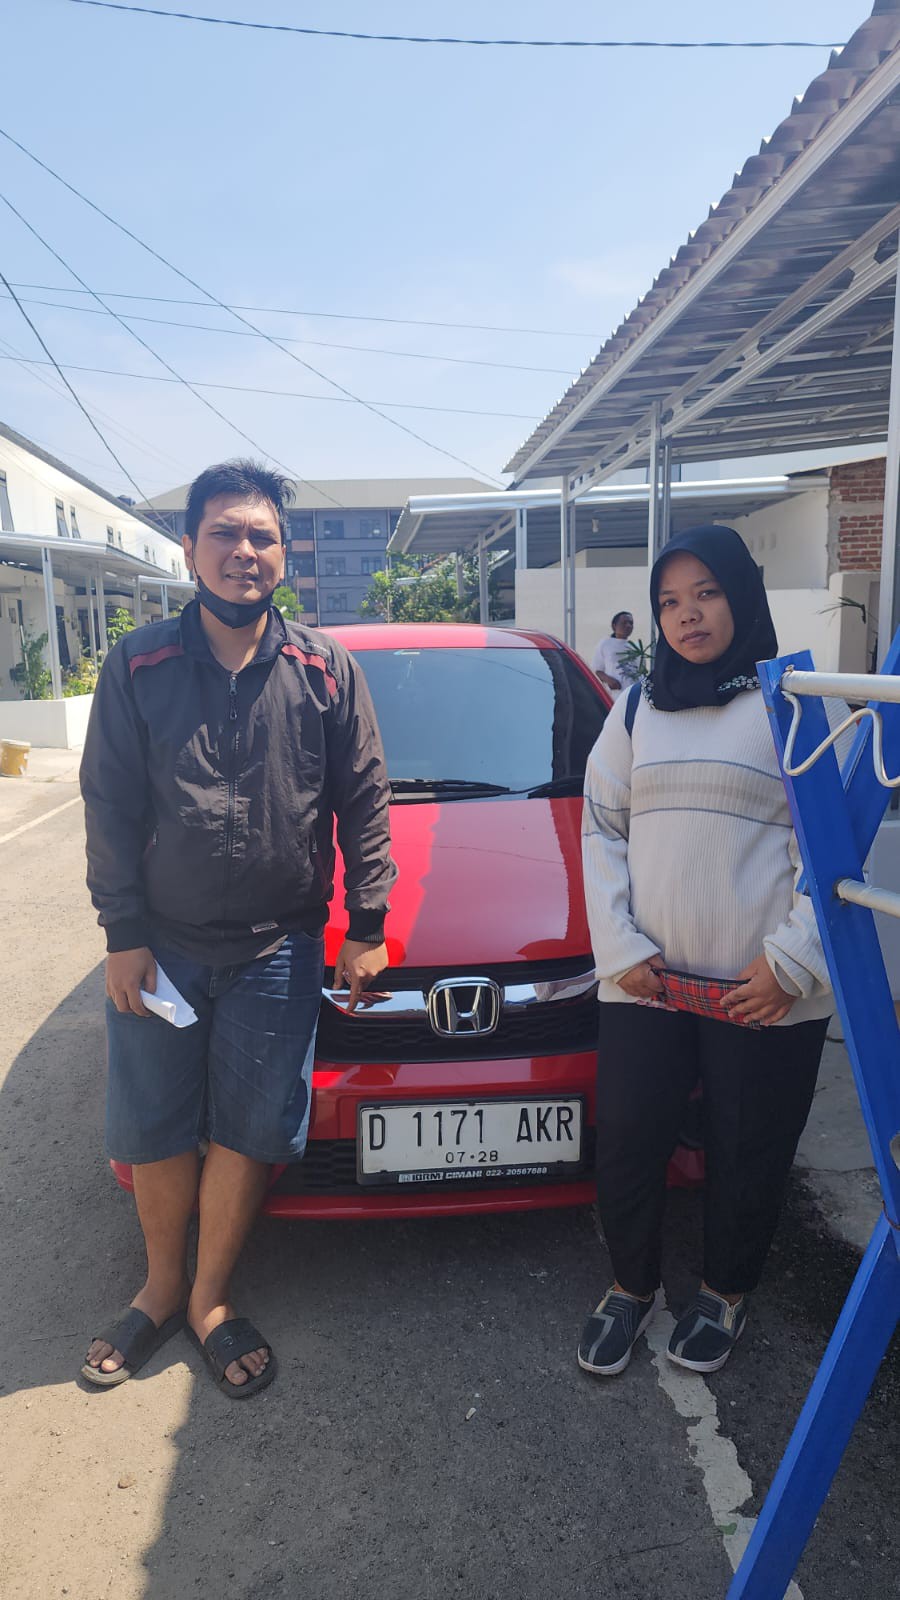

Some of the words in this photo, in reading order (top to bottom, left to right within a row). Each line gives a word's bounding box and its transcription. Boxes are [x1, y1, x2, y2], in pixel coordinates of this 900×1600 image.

[369, 1113, 386, 1150] D
[412, 1109, 484, 1147] 1171
[516, 1106, 574, 1142] AKR
[445, 1170, 483, 1179] CIMAHI
